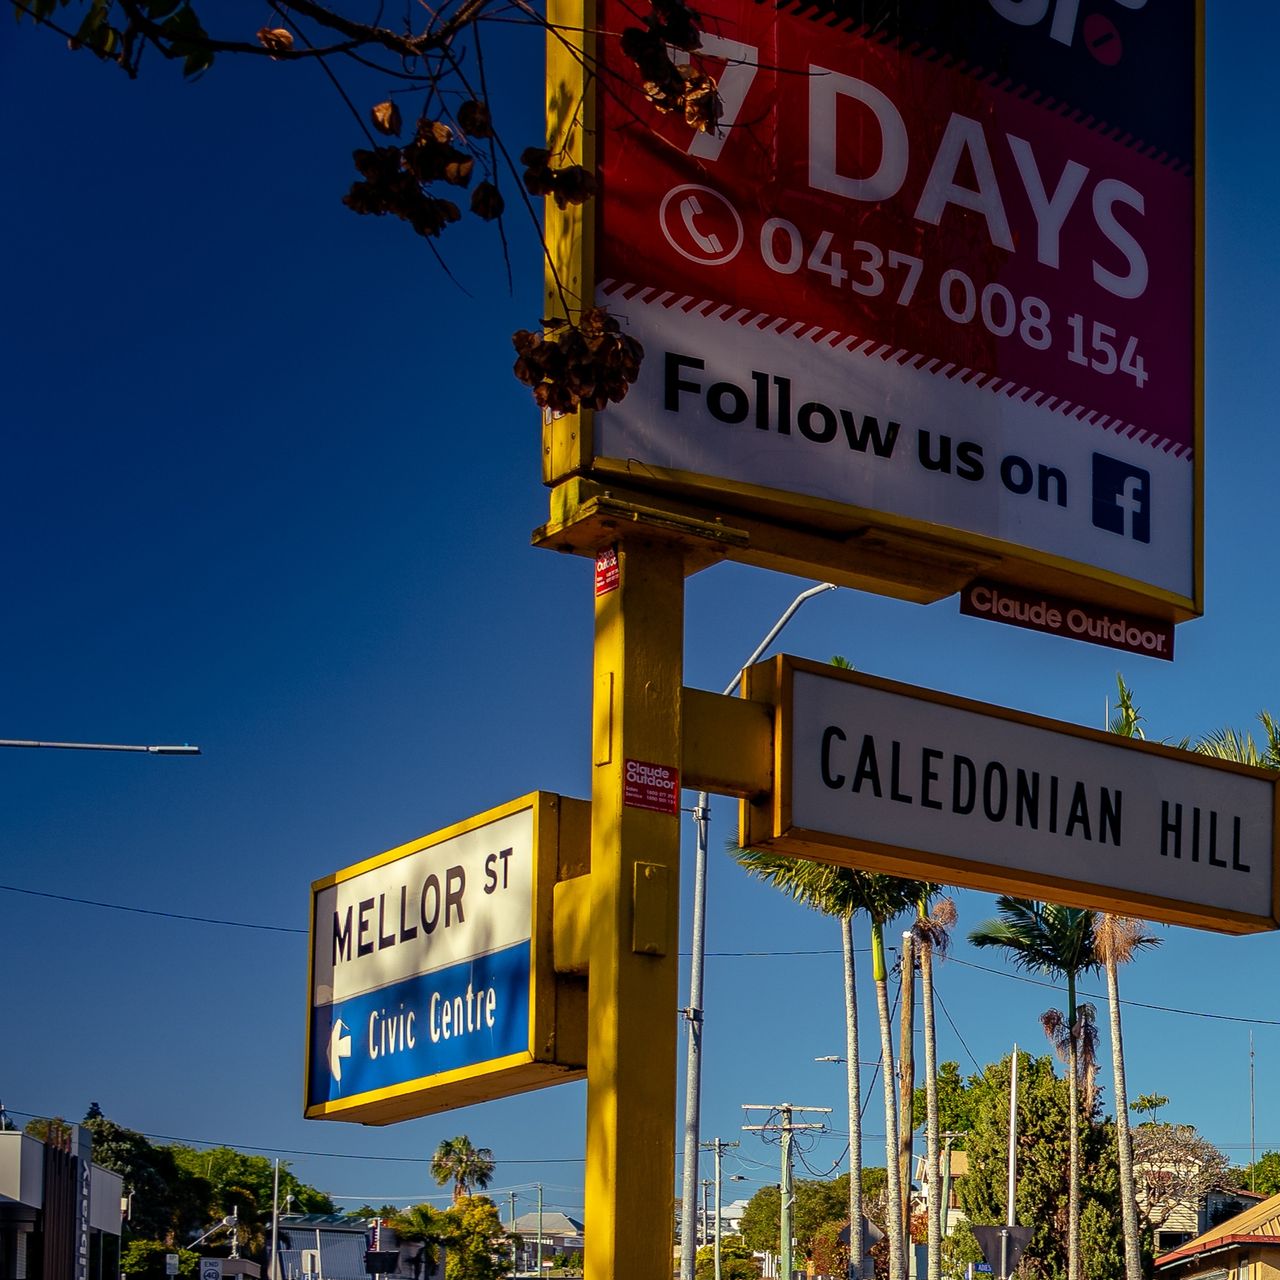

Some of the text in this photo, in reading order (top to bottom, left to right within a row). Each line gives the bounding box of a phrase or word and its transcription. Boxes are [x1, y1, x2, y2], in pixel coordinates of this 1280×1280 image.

[664, 28, 1151, 300] 7 DAYS
[759, 217, 1149, 388] 0437 008 154
[664, 351, 900, 459] Follow
[917, 429, 985, 482] us
[1001, 455, 1068, 508] on
[970, 586, 1167, 653] Claude Outdoor
[626, 761, 670, 779] Claude
[626, 771, 675, 790] Outdoor
[820, 725, 1252, 874] CALEDONIAN HILL
[332, 847, 513, 967] MELLOR ST
[367, 985, 497, 1061] Civic Centre
